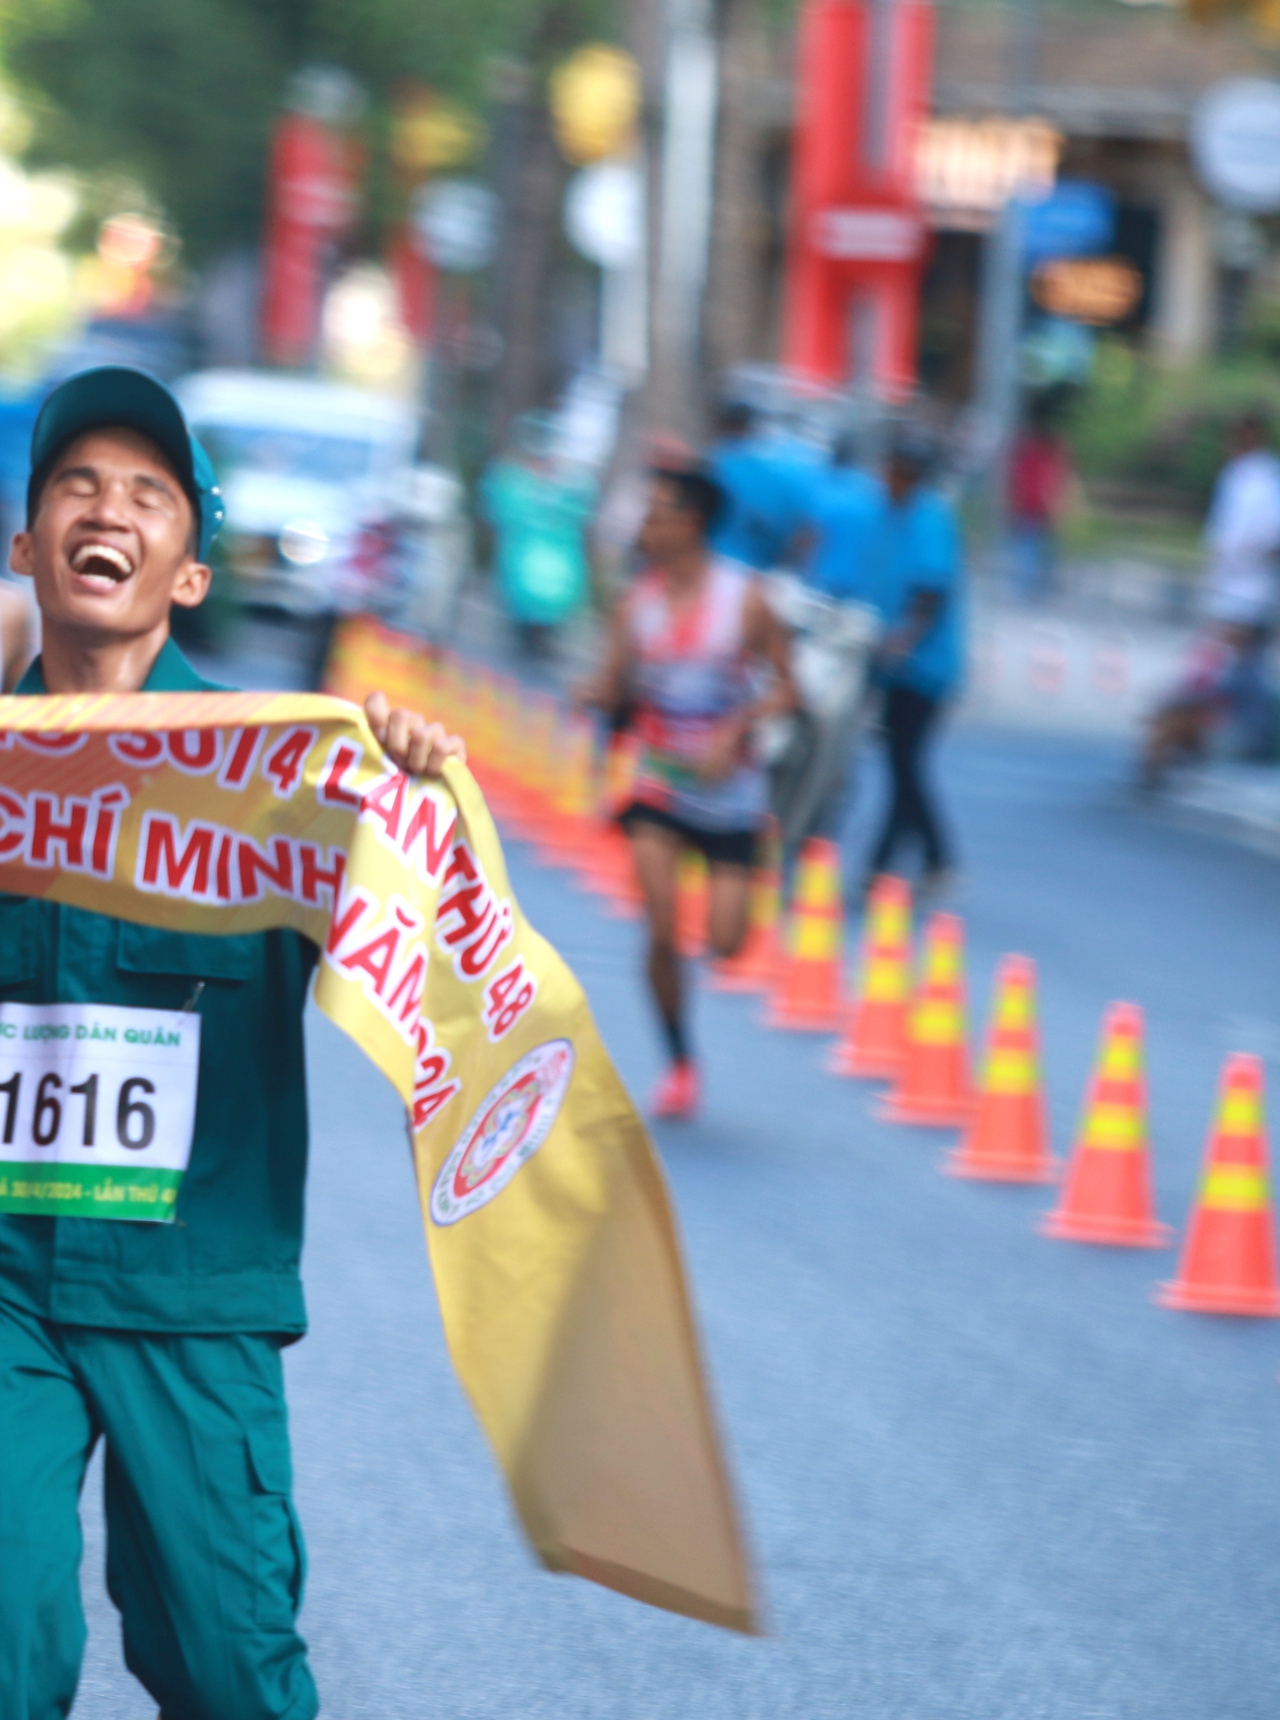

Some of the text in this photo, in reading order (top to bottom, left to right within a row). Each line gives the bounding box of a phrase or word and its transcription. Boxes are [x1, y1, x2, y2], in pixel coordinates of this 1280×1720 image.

[139, 815, 348, 905] MINH
[74, 1021, 117, 1041] DÂN
[123, 1025, 181, 1047] QUÂN
[485, 960, 537, 1039] 48
